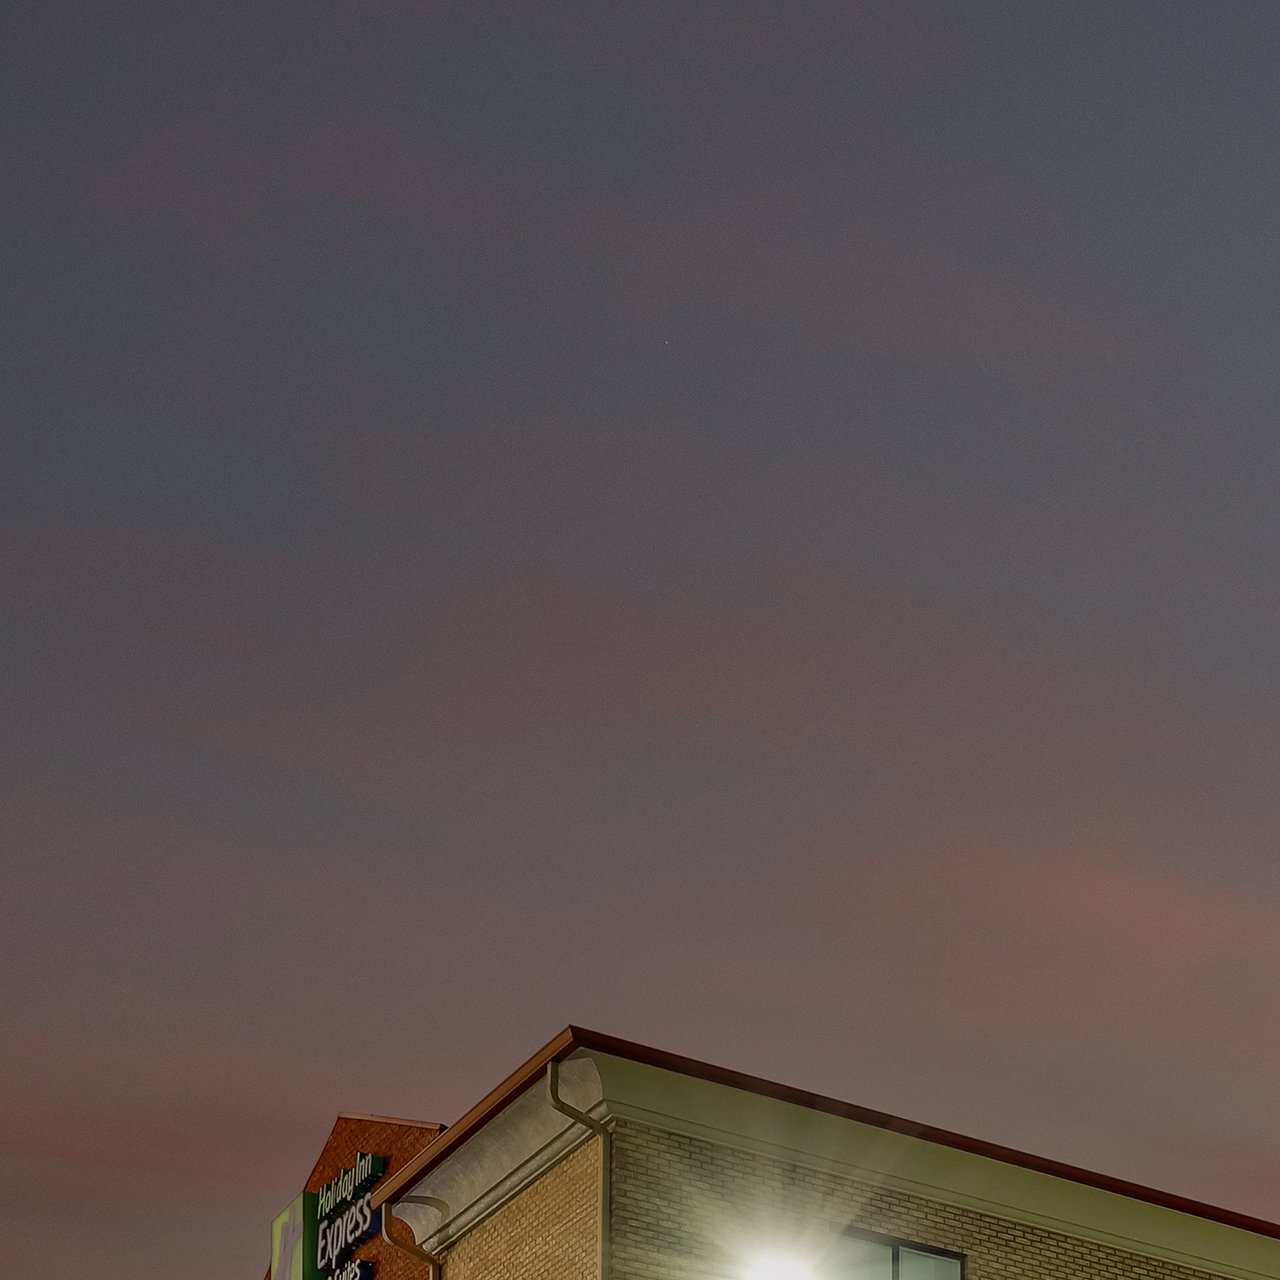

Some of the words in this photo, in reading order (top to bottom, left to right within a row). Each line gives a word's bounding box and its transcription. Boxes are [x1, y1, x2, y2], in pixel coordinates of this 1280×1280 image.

[317, 1168, 355, 1220] Holiday
[354, 1152, 373, 1187] Inn
[317, 1192, 372, 1270] Express
